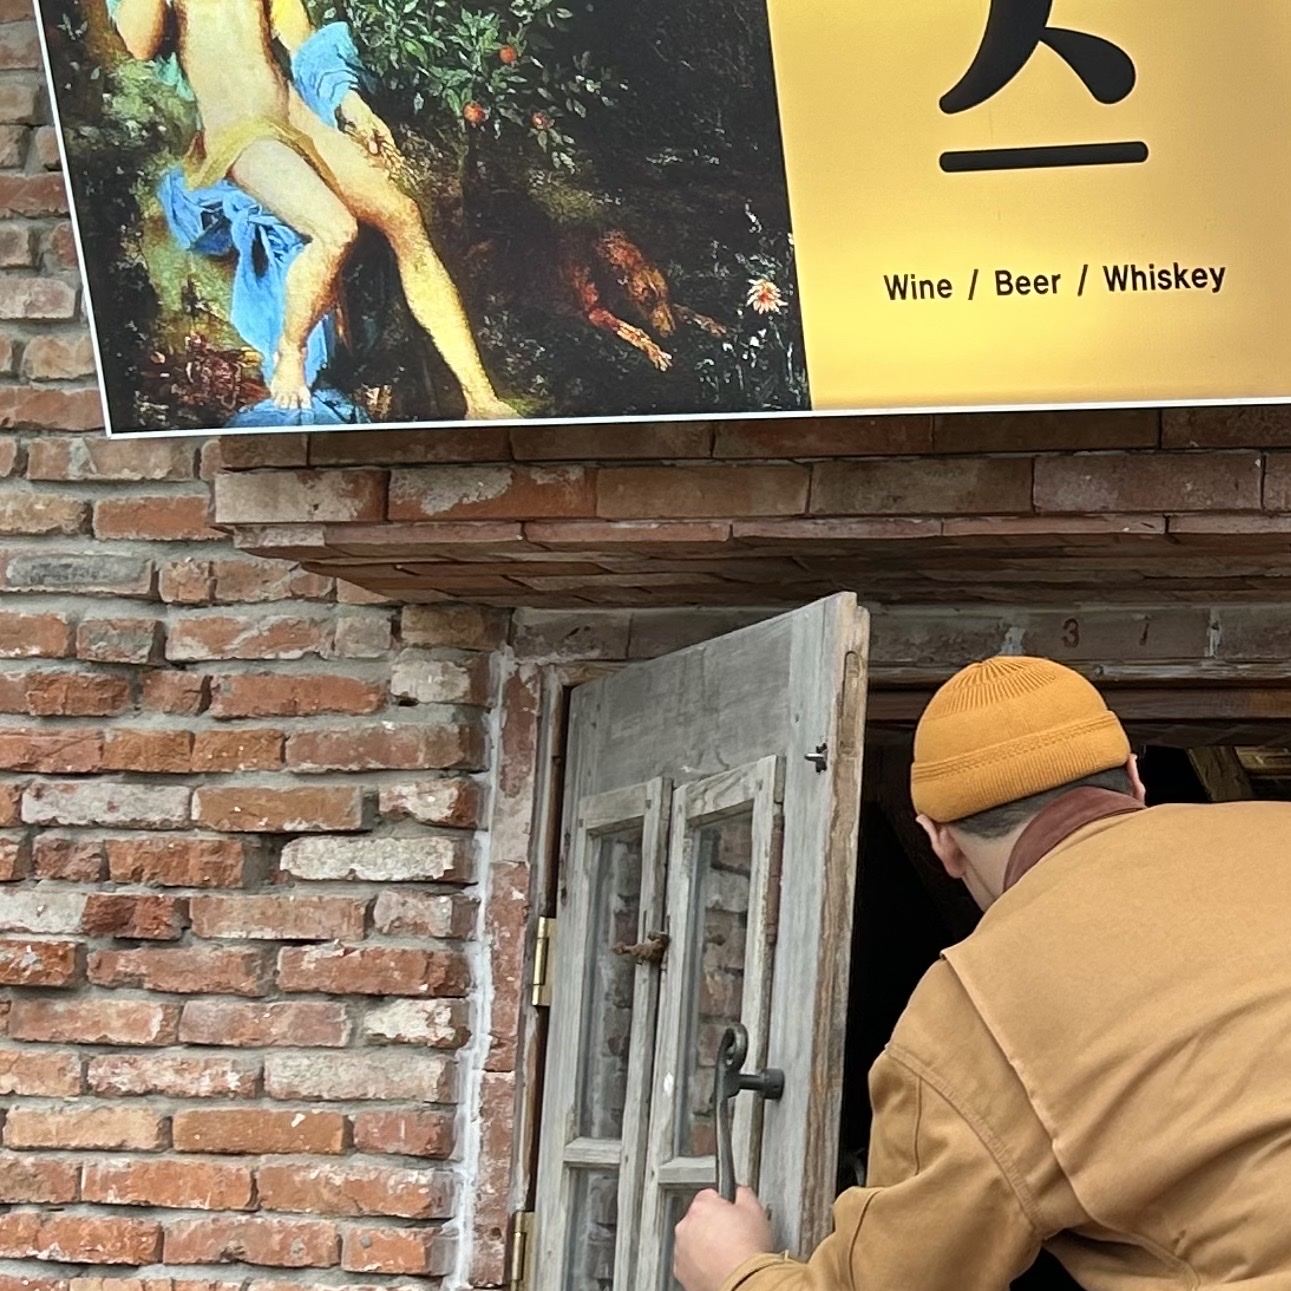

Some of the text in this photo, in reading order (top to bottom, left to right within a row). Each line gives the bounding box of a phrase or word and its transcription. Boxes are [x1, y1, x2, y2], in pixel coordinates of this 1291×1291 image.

[884, 273, 953, 300] Wine
[994, 270, 1062, 296] Beer
[1103, 262, 1226, 294] Whiskey
